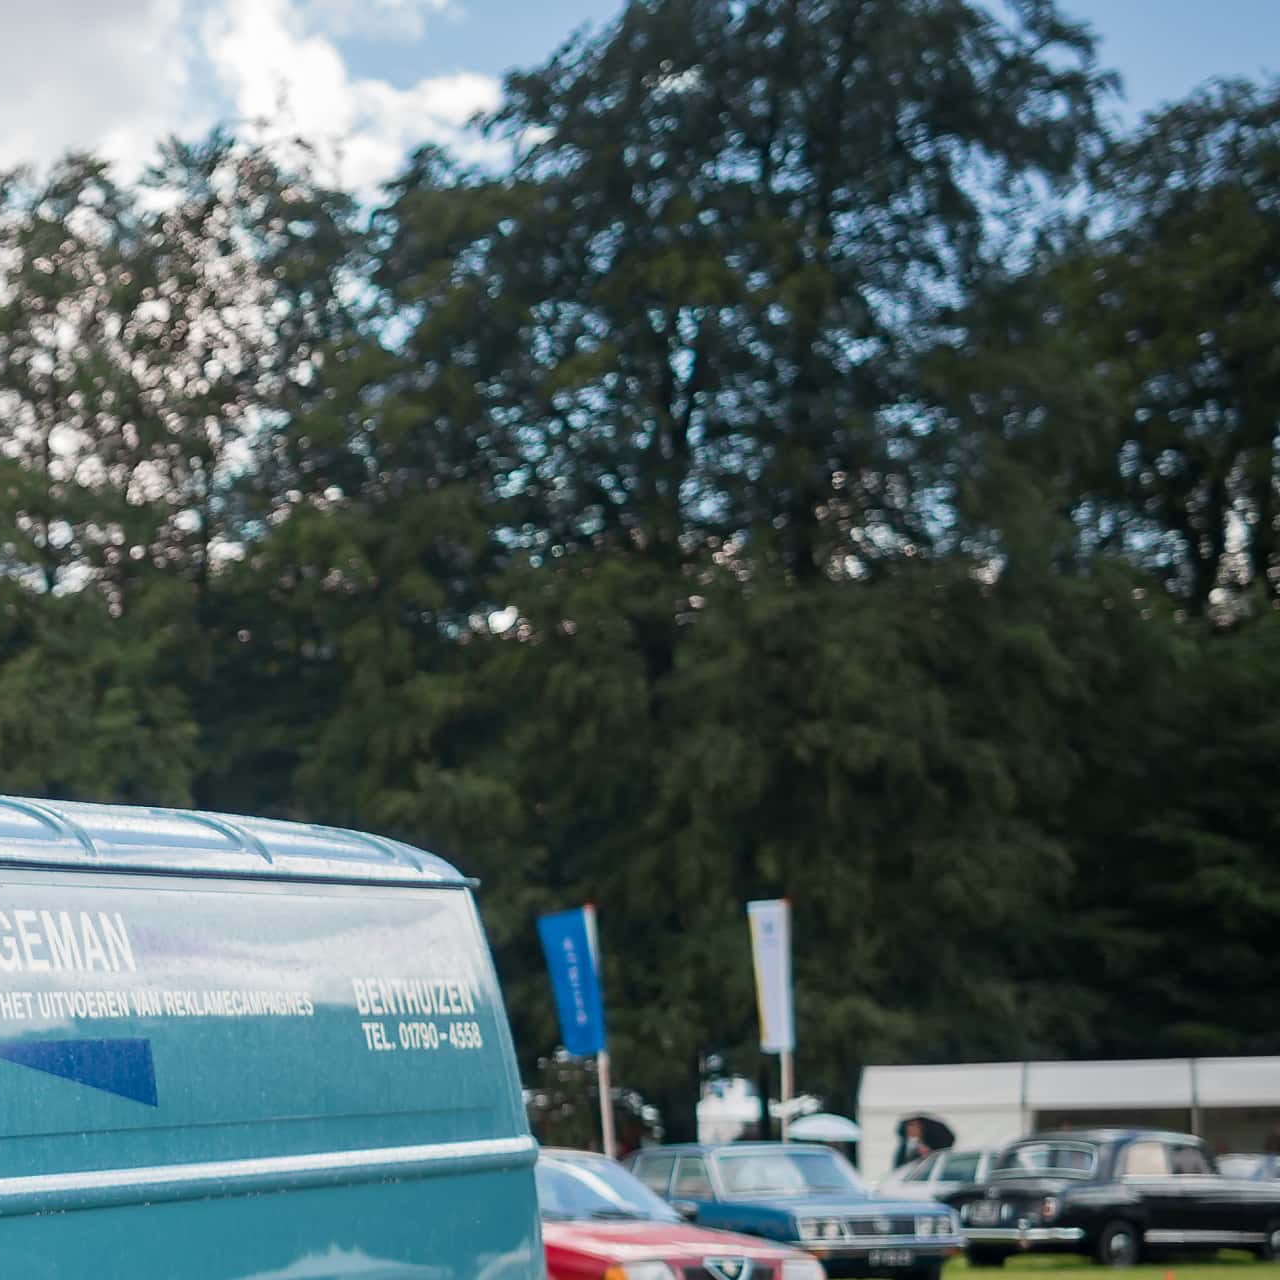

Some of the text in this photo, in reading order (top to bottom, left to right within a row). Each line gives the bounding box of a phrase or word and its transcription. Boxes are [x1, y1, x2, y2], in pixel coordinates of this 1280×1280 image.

[0, 992, 33, 1019] HET
[38, 991, 130, 1019] UITVOEREN
[130, 991, 163, 1017] VAN
[163, 991, 315, 1017] REKLAMECAMPAGNES
[352, 978, 476, 1015] BENTHUIZEN
[361, 1022, 397, 1050] TEL.
